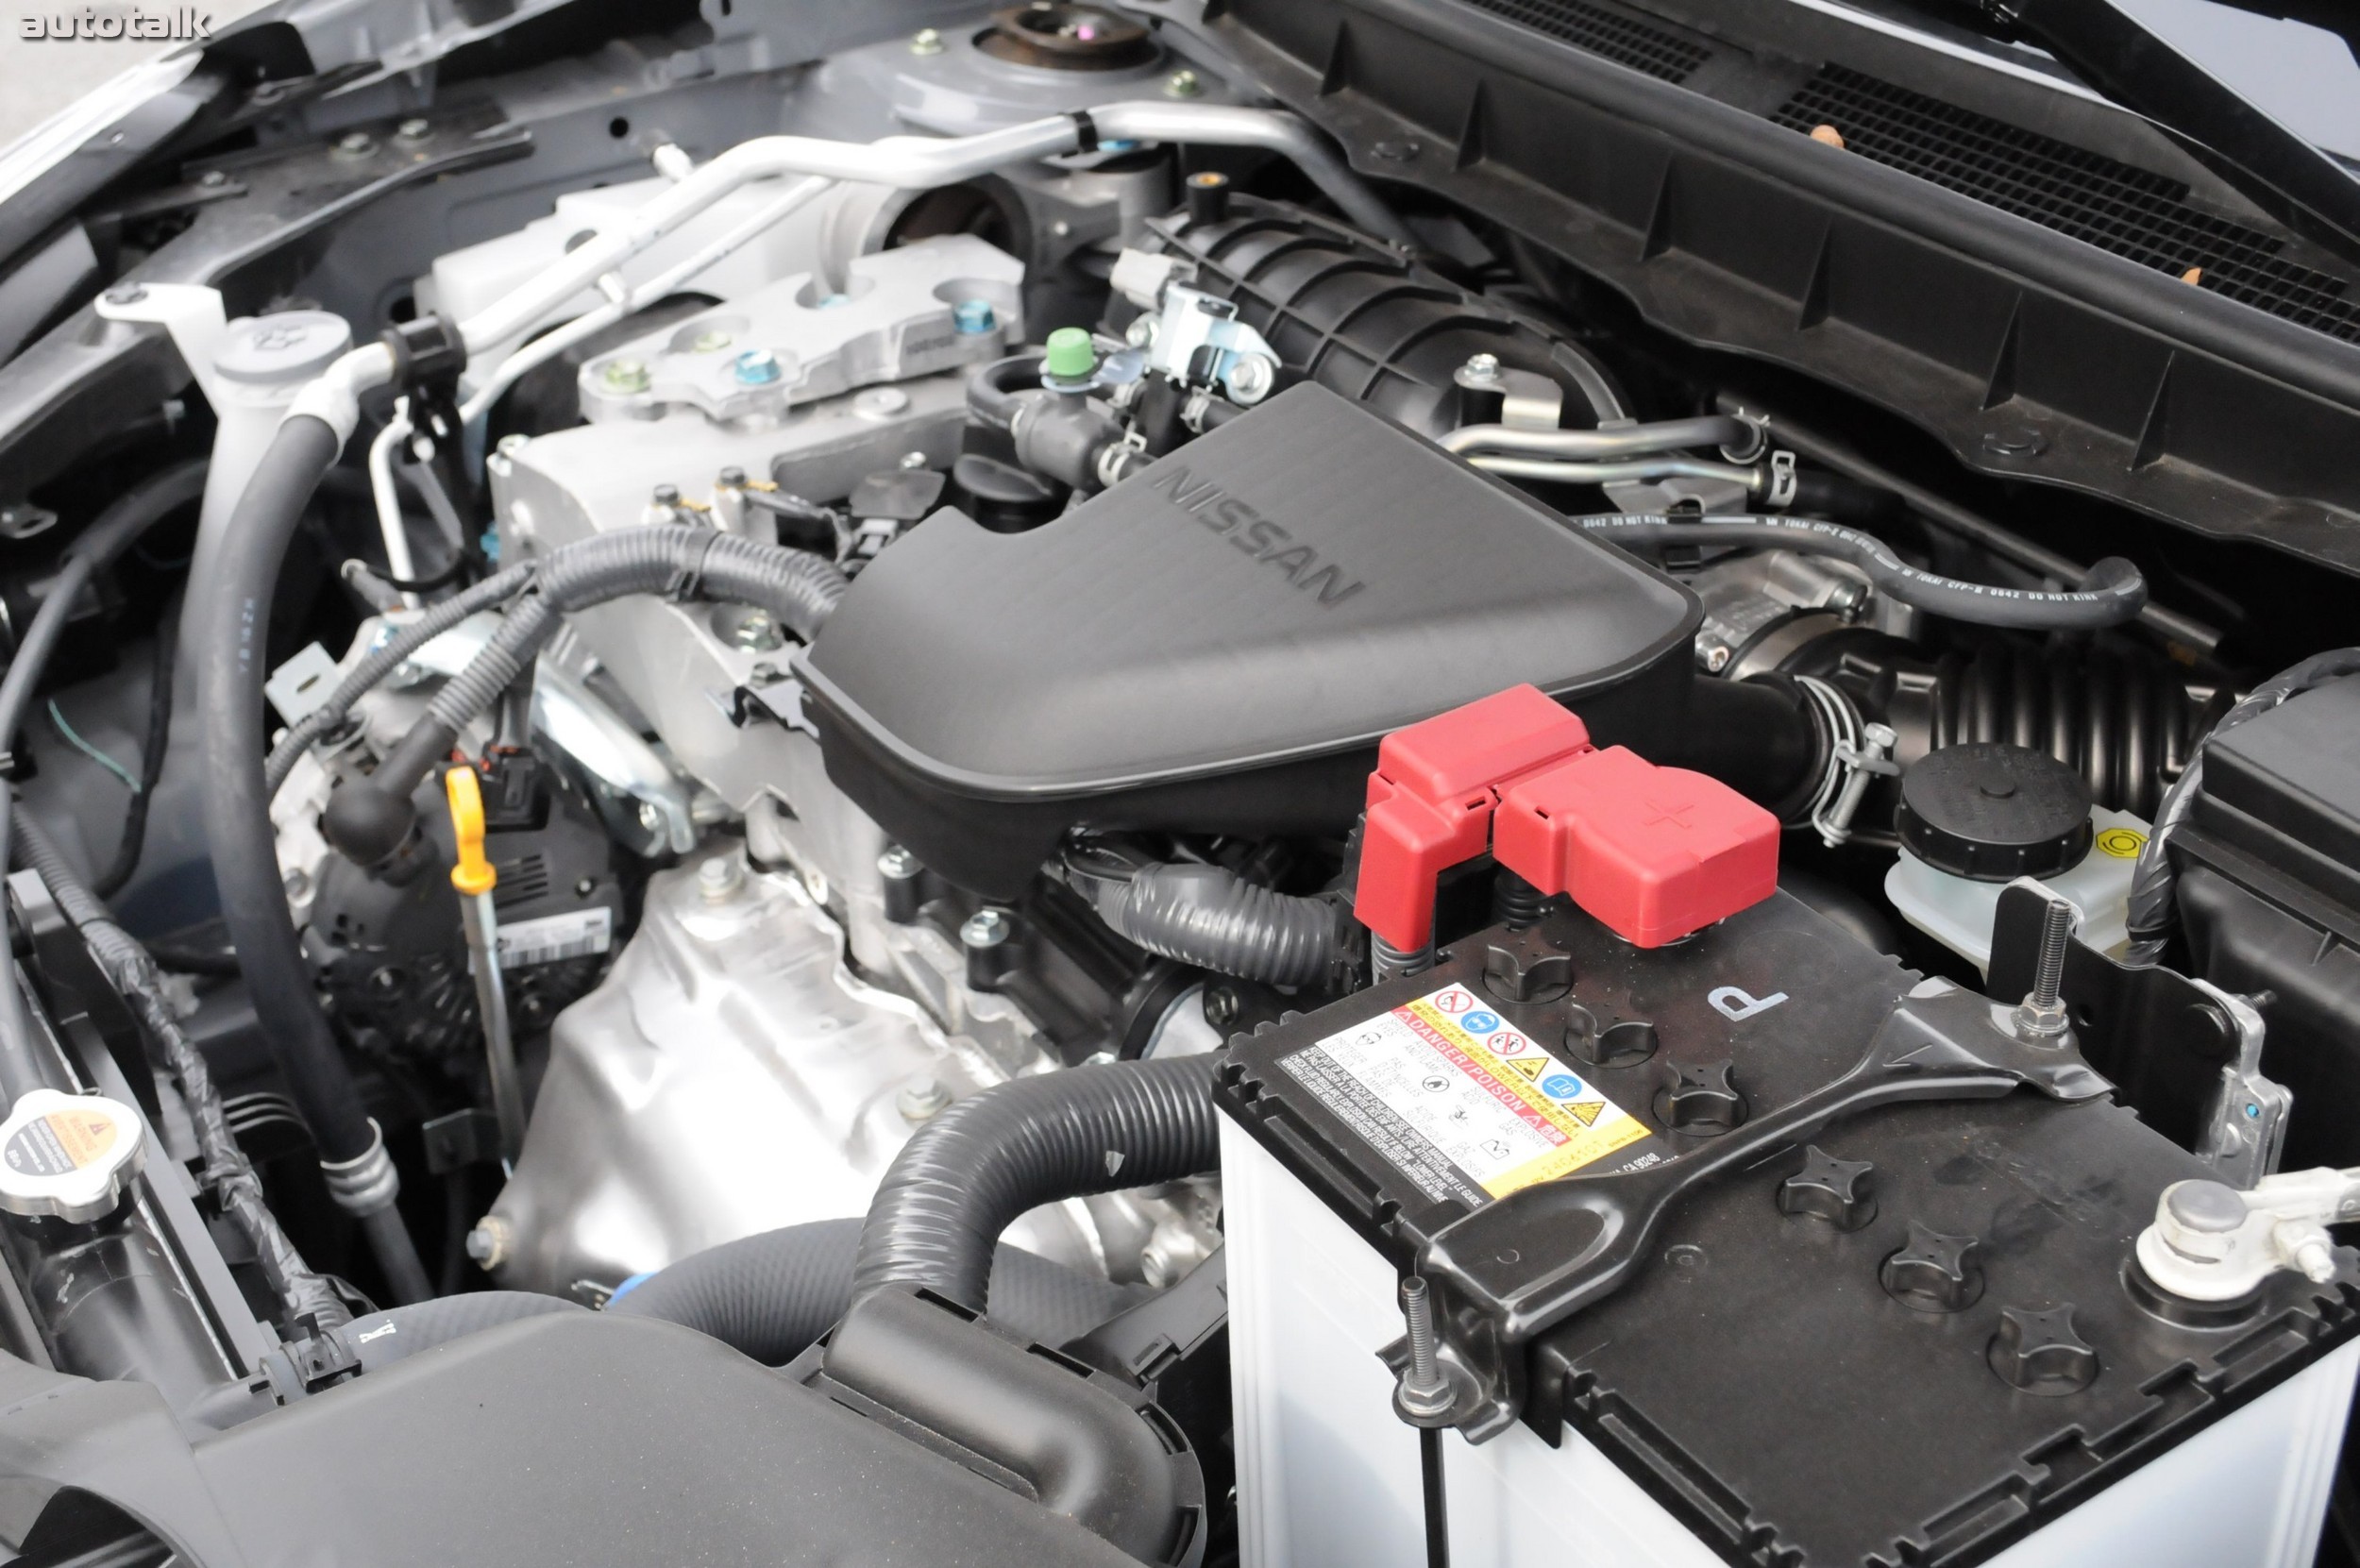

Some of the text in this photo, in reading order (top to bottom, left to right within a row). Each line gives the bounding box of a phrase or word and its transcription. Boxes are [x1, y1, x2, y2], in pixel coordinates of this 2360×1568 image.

[1151, 465, 1367, 610] NISSAN
[2029, 592, 2044, 600] DO
[2048, 593, 2069, 601] NOT
[2072, 593, 2099, 601] KINK
[1374, 1021, 1397, 1037] EYES
[1386, 1018, 1414, 1037] SHIELD
[1298, 1049, 1313, 1058] NE
[1305, 1054, 1322, 1066] PAS
[1401, 1043, 1442, 1074] AND FLAME
[1412, 1038, 1463, 1077] AVOID SPARKS
[1278, 1056, 1305, 1076] VERIFIER
[1306, 1045, 1326, 1058] KEEP
[1319, 1055, 1336, 1067] OUT
[1329, 1064, 1343, 1073] OF
[1336, 1071, 1354, 1082] THE
[1345, 1078, 1370, 1095] REACH
[1361, 1092, 1376, 1102] OF
[1314, 1063, 1341, 1084] LAISSER
[1296, 1072, 1310, 1081] LE
[1302, 1078, 1326, 1095] LIQUIDE
[1339, 1084, 1353, 1093] LA
[1345, 1089, 1371, 1108] PORTEE
[1458, 1089, 1481, 1105] ACID
[1469, 1085, 1508, 1113] SULFURIC
[1288, 1054, 1309, 1069] CHECK
[1301, 1065, 1321, 1079] FLUID
[1338, 1097, 1369, 1121] EXPLOSION
[1360, 1117, 1378, 1129] CAN
[1370, 1125, 1394, 1142] RESULT
[1391, 1143, 1415, 1161] BELOW
[1363, 1105, 1382, 1118] DES
[1496, 1121, 1518, 1136] GAS
[1507, 1117, 1550, 1148] EXPLOSIVE
[1536, 1123, 1569, 1144] 危険
[1393, 1158, 1408, 1167] SI
[1410, 1146, 1459, 1185] ATTENTIVEMENT
[1633, 1153, 1660, 1170] 90248
[1399, 1163, 1431, 1188] INFERIEUR
[1423, 1184, 1439, 1193] AU
[1452, 1183, 1467, 1191] LE
[1429, 1189, 1449, 1203] NIVE
